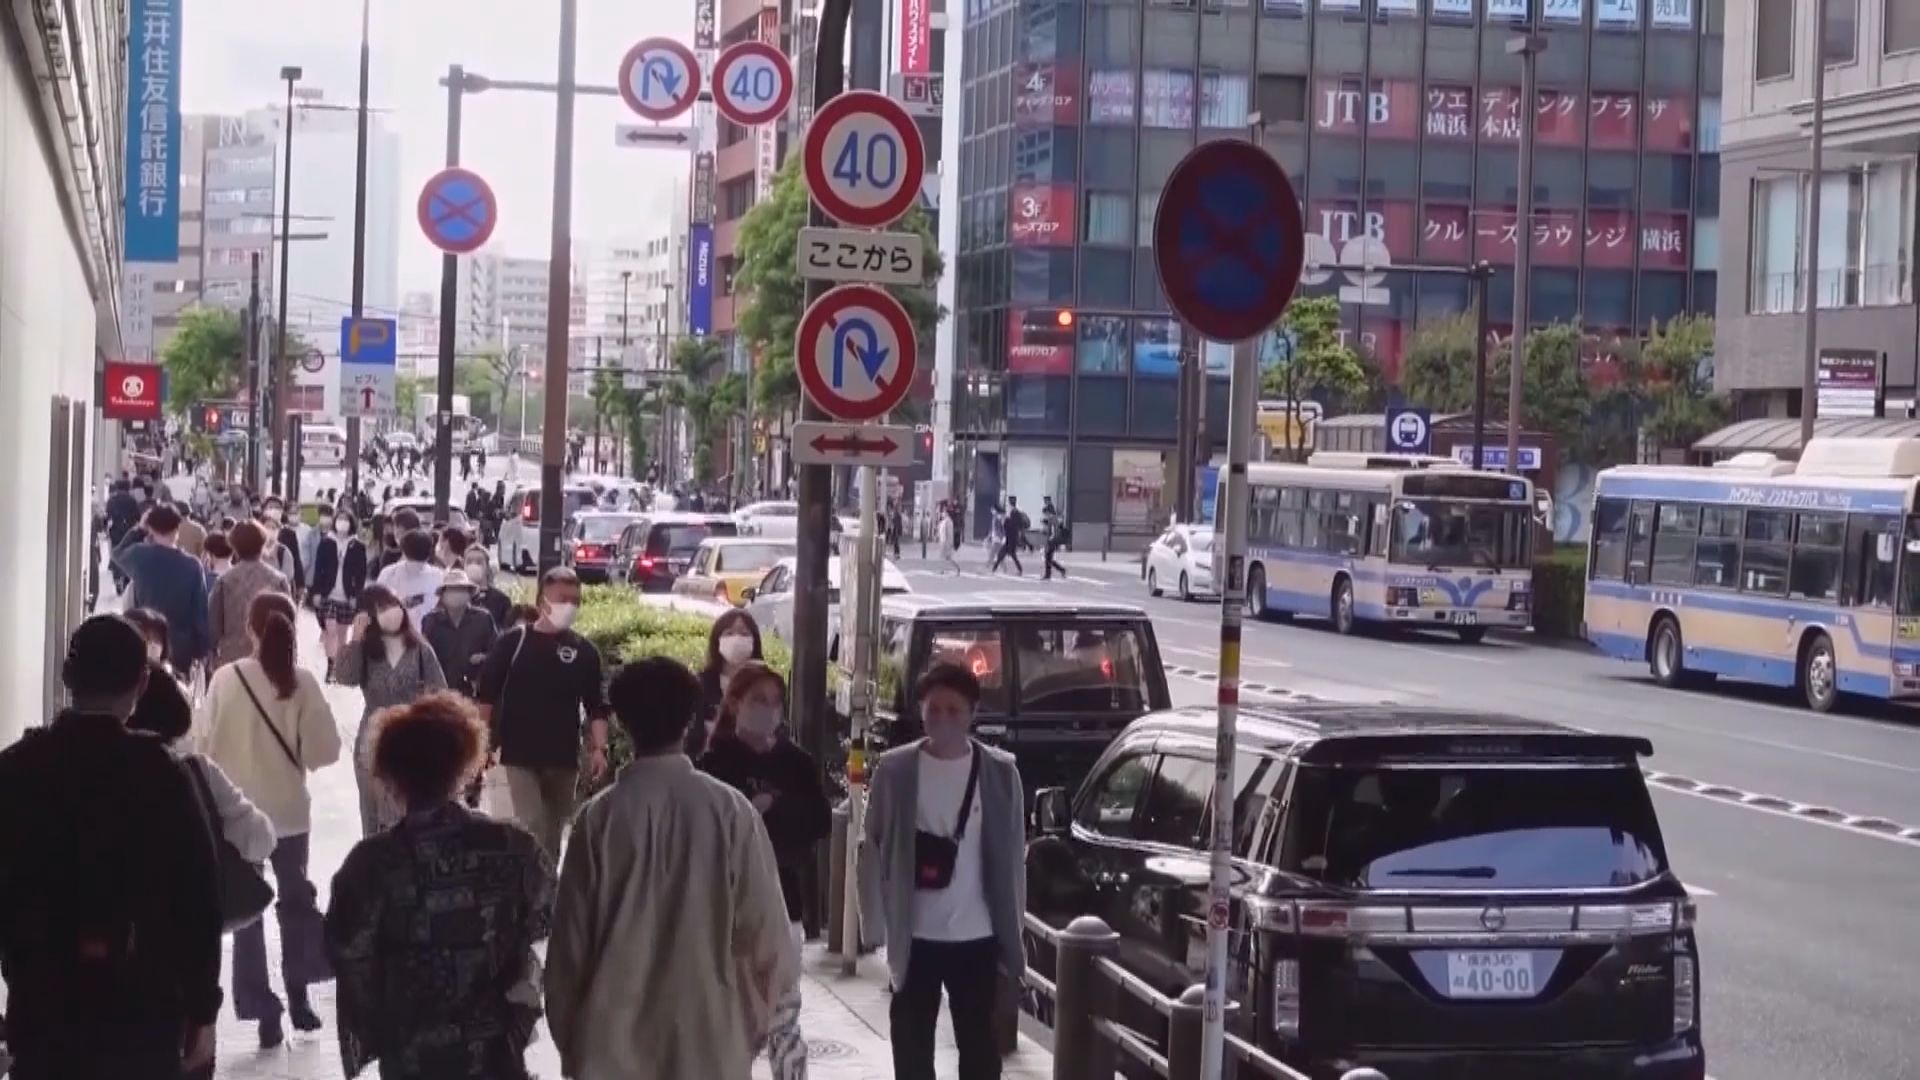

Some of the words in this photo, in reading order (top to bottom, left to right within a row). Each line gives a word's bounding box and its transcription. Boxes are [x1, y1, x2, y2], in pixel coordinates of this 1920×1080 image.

[730, 65, 774, 101] 40
[139, 0, 170, 217] 三井住友信託銀行
[1318, 91, 1389, 128] JTB
[833, 131, 897, 189] 40
[1022, 196, 1041, 218] 3F
[809, 242, 913, 273] ここから
[349, 321, 389, 355] P
[1467, 968, 1529, 992] 40-00
